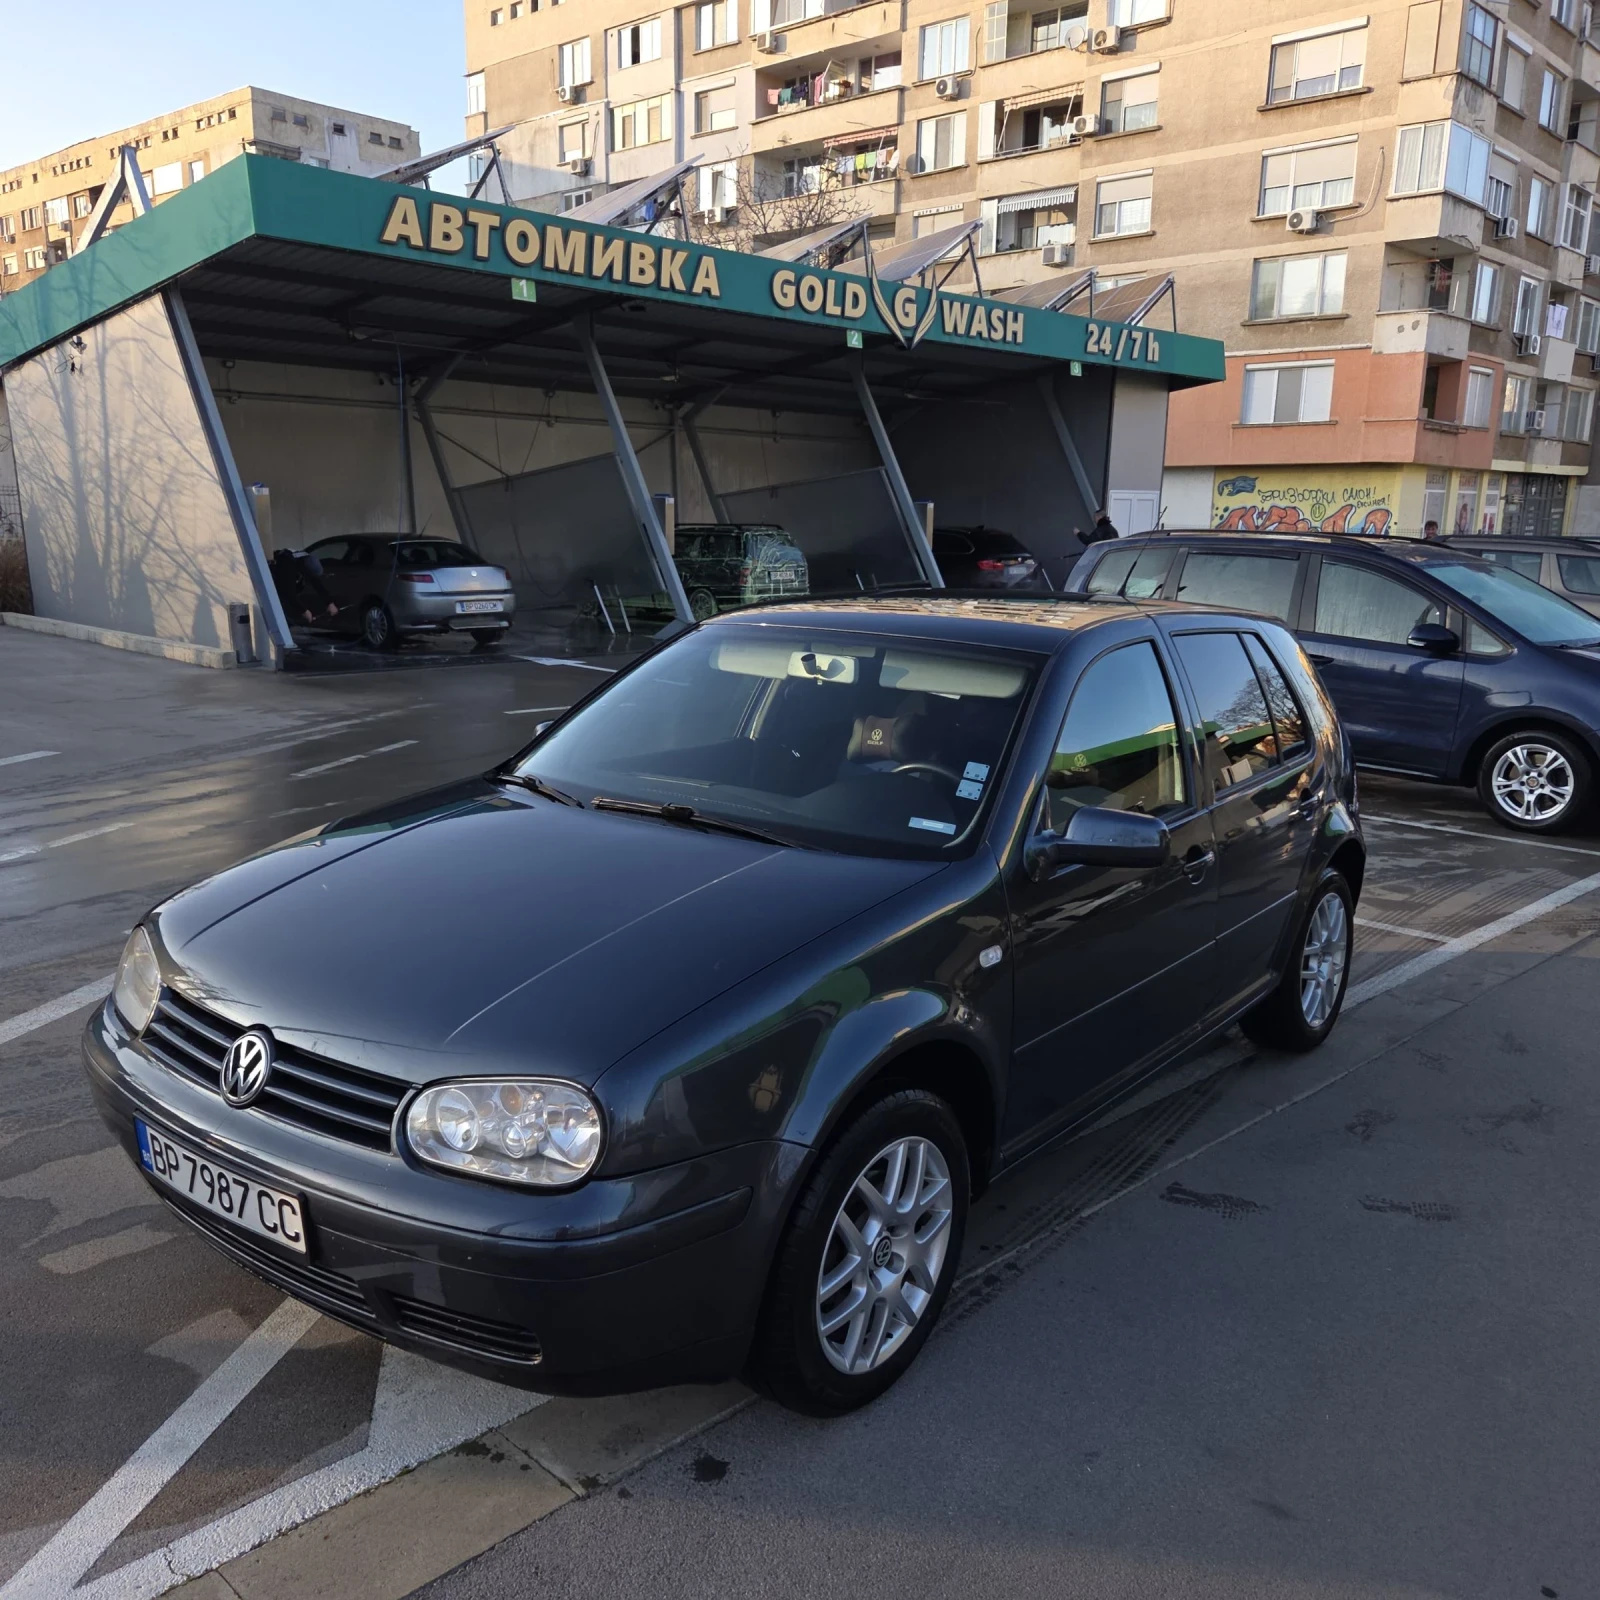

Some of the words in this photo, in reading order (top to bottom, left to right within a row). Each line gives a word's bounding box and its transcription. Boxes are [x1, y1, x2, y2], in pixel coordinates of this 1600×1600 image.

[380, 195, 721, 298] АВТОМИВКА
[518, 278, 528, 298] 1
[772, 269, 868, 320] GOLD
[893, 287, 918, 329] G
[941, 299, 1025, 345] WASH
[851, 330, 860, 344] 2
[1073, 363, 1080, 374] 3
[150, 1132, 180, 1181] BP
[183, 1152, 250, 1219] 7987
[256, 1189, 302, 1243] CC
